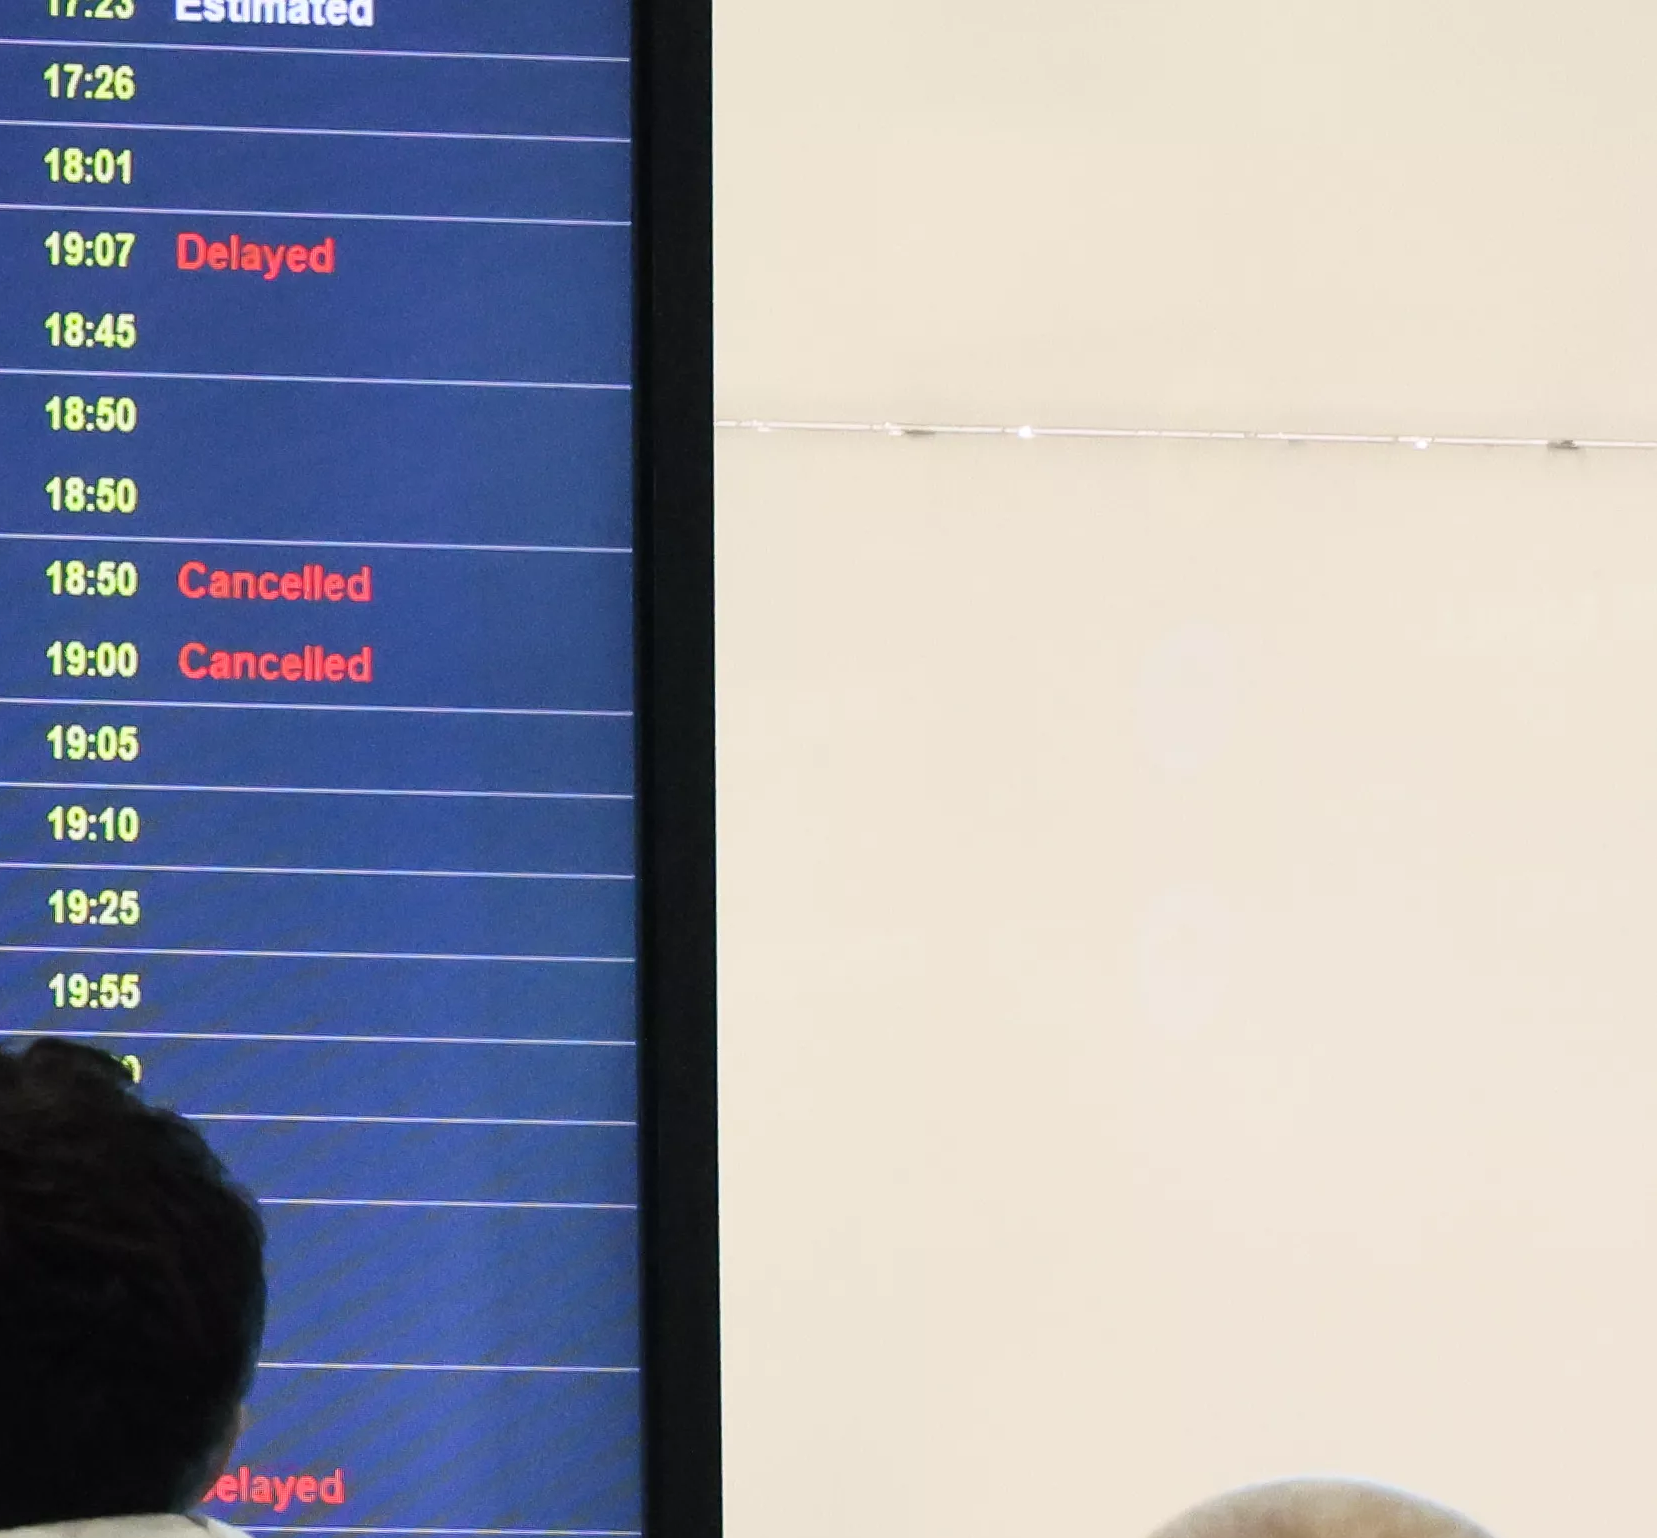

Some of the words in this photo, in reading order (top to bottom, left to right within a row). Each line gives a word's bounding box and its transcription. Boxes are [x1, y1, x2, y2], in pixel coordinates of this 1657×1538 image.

[44, 63, 135, 100] 17:26
[45, 231, 135, 267] 19:07
[177, 233, 334, 280] Delayed
[45, 396, 136, 432] 18:50
[46, 560, 137, 596] 18:50
[178, 562, 371, 601] Cancelled
[47, 641, 138, 677] 19:00
[179, 642, 372, 682] Cancelled
[47, 725, 139, 761] 19:05
[49, 973, 141, 1008] 19:55
